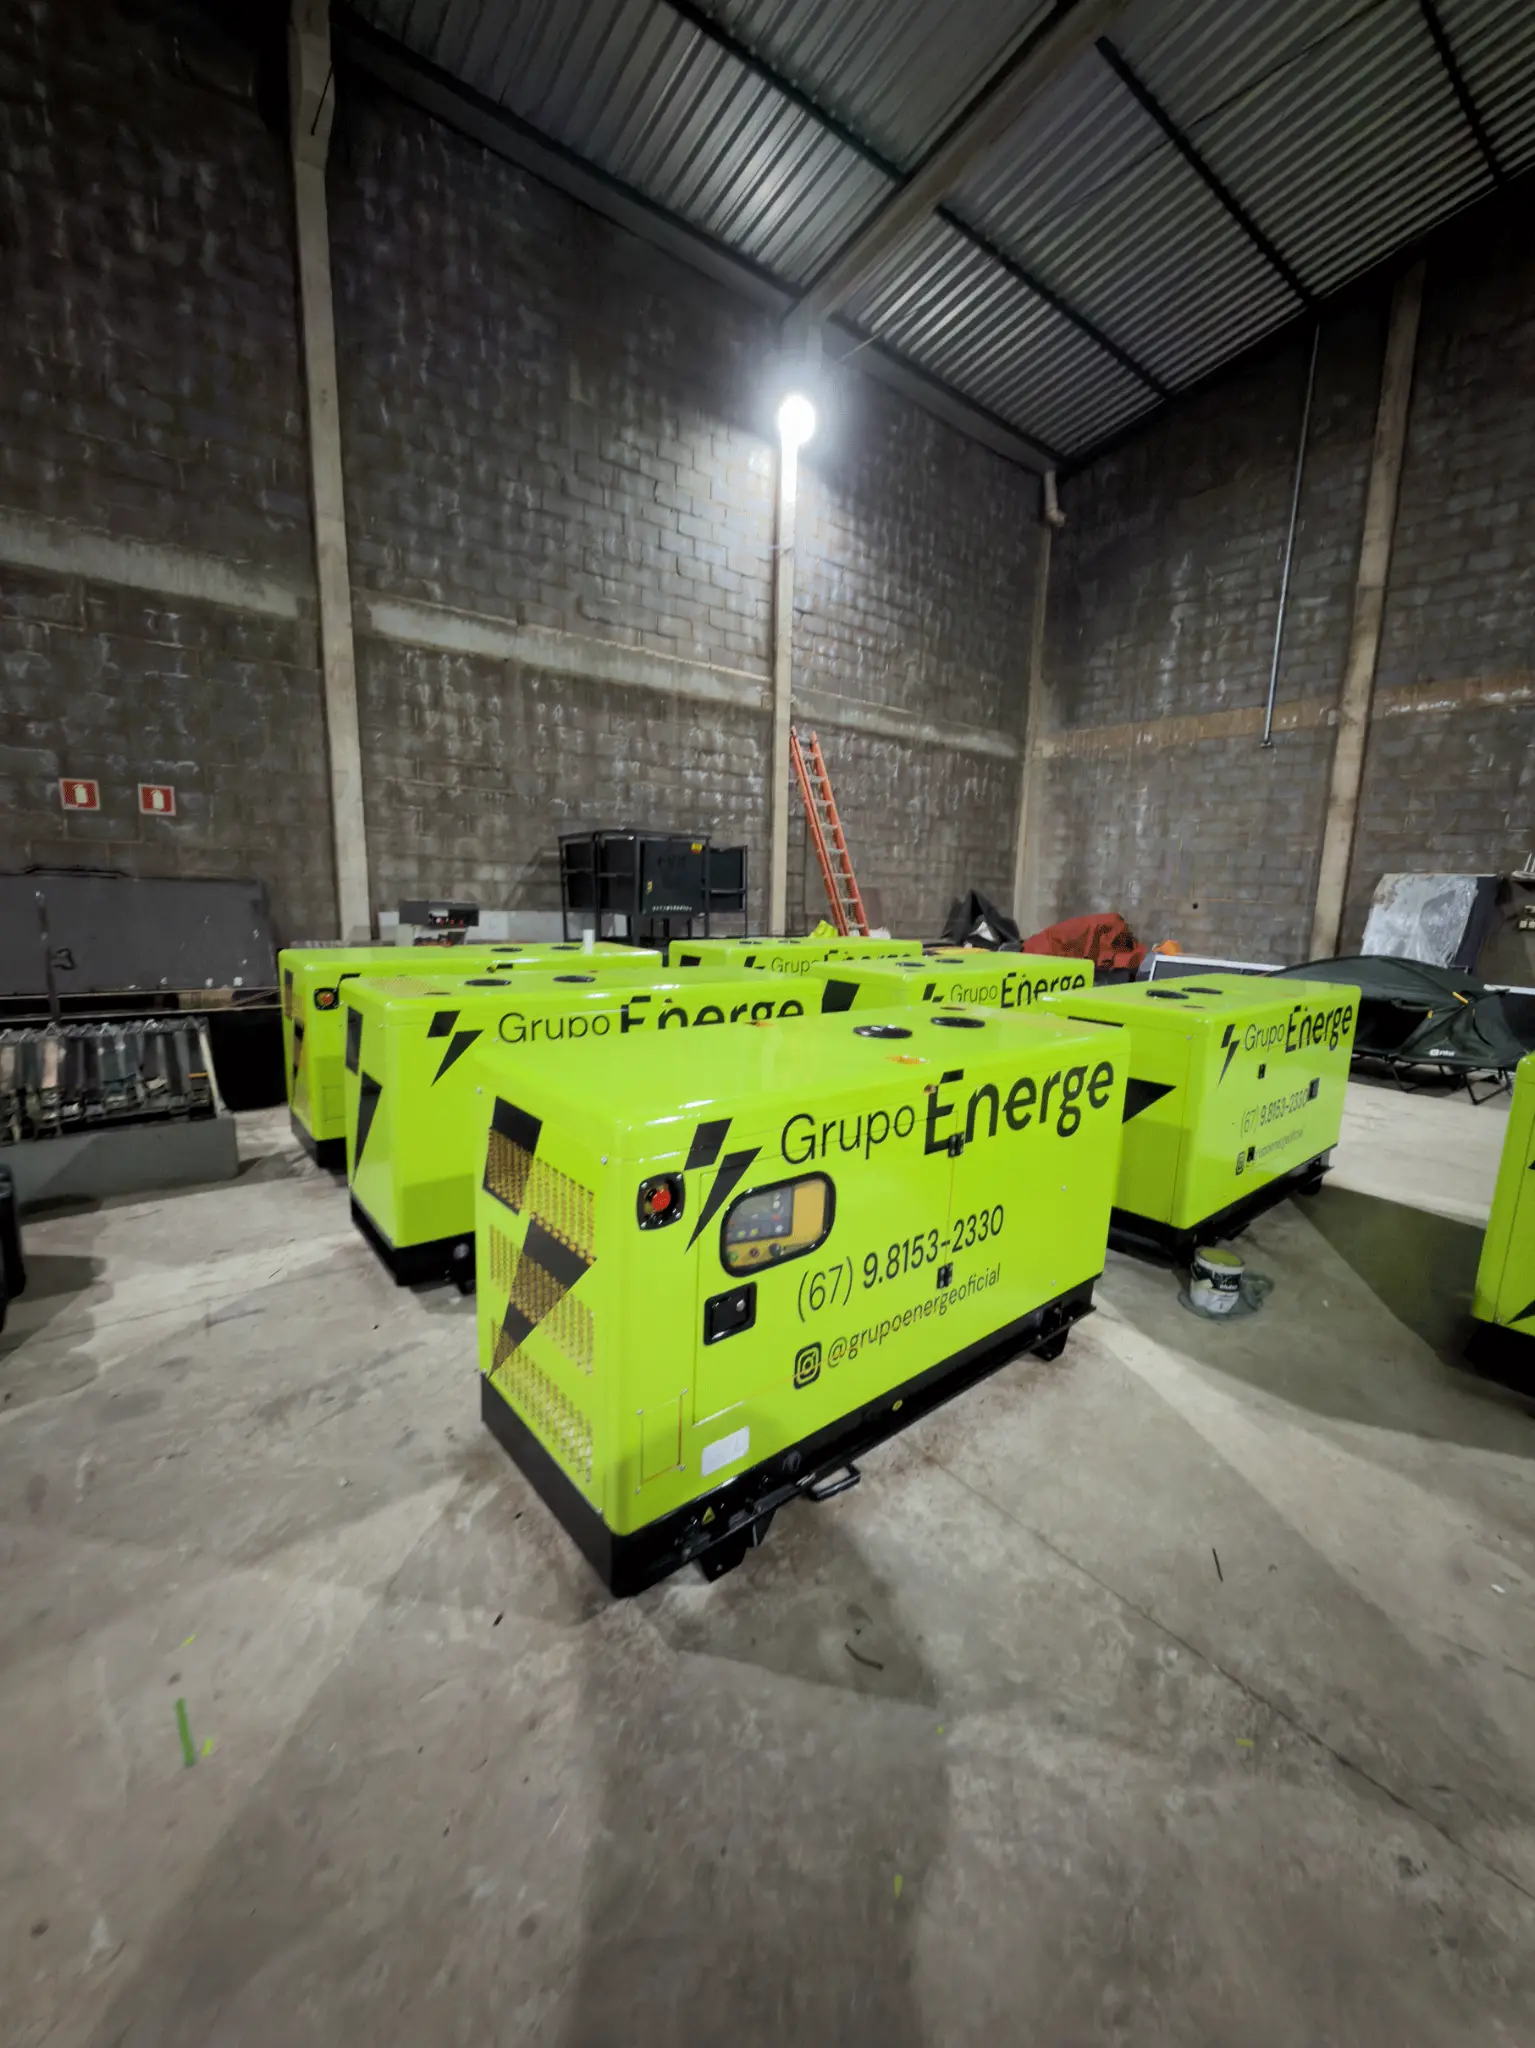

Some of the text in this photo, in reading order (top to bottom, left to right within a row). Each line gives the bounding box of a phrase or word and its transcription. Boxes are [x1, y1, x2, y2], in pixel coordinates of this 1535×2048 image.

[771, 956, 820, 976] Grup
[950, 983, 998, 1003] Grupo
[499, 1012, 611, 1043] Grupo
[1244, 1005, 1353, 1054] Grupo Energe
[781, 1061, 1114, 1165] Grupo Energe
[798, 1204, 1004, 1322] (67) 9.8153-2330
[828, 1262, 1001, 1368] @grupoenergeoficial
